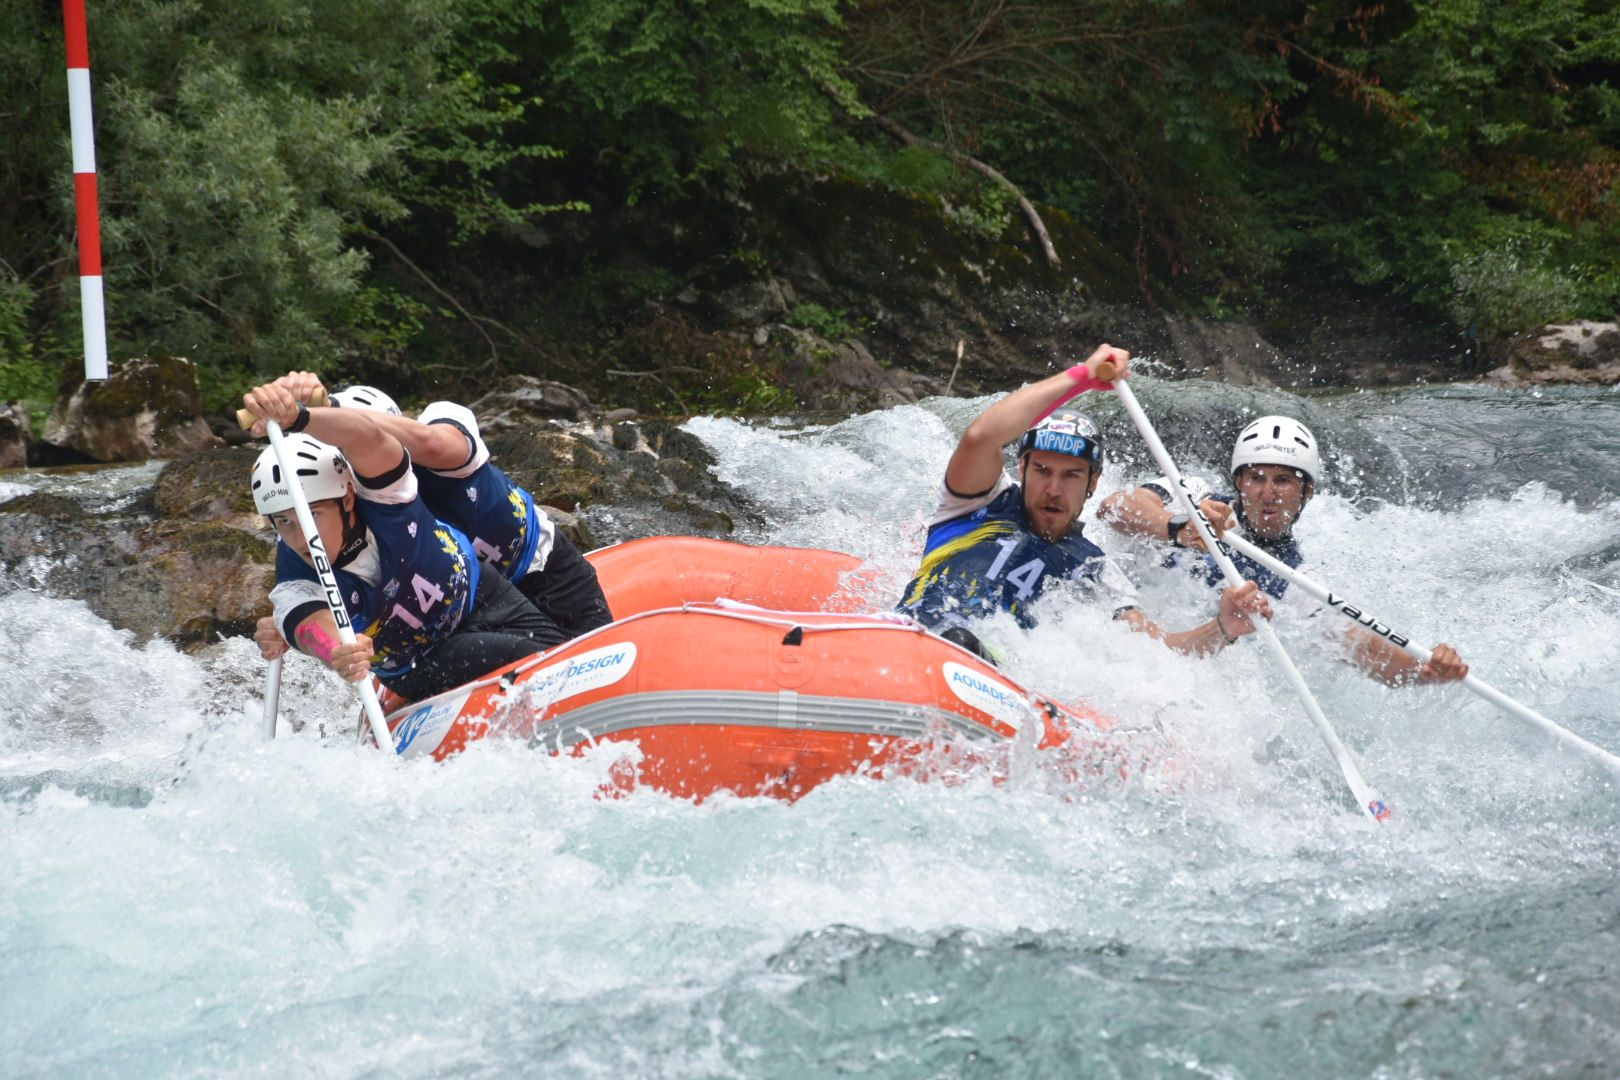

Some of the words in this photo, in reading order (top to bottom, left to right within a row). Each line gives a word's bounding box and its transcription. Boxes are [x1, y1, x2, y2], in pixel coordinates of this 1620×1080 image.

[1034, 430, 1086, 457] RIPNDIP
[985, 537, 1046, 602] 14
[384, 572, 445, 630] 14
